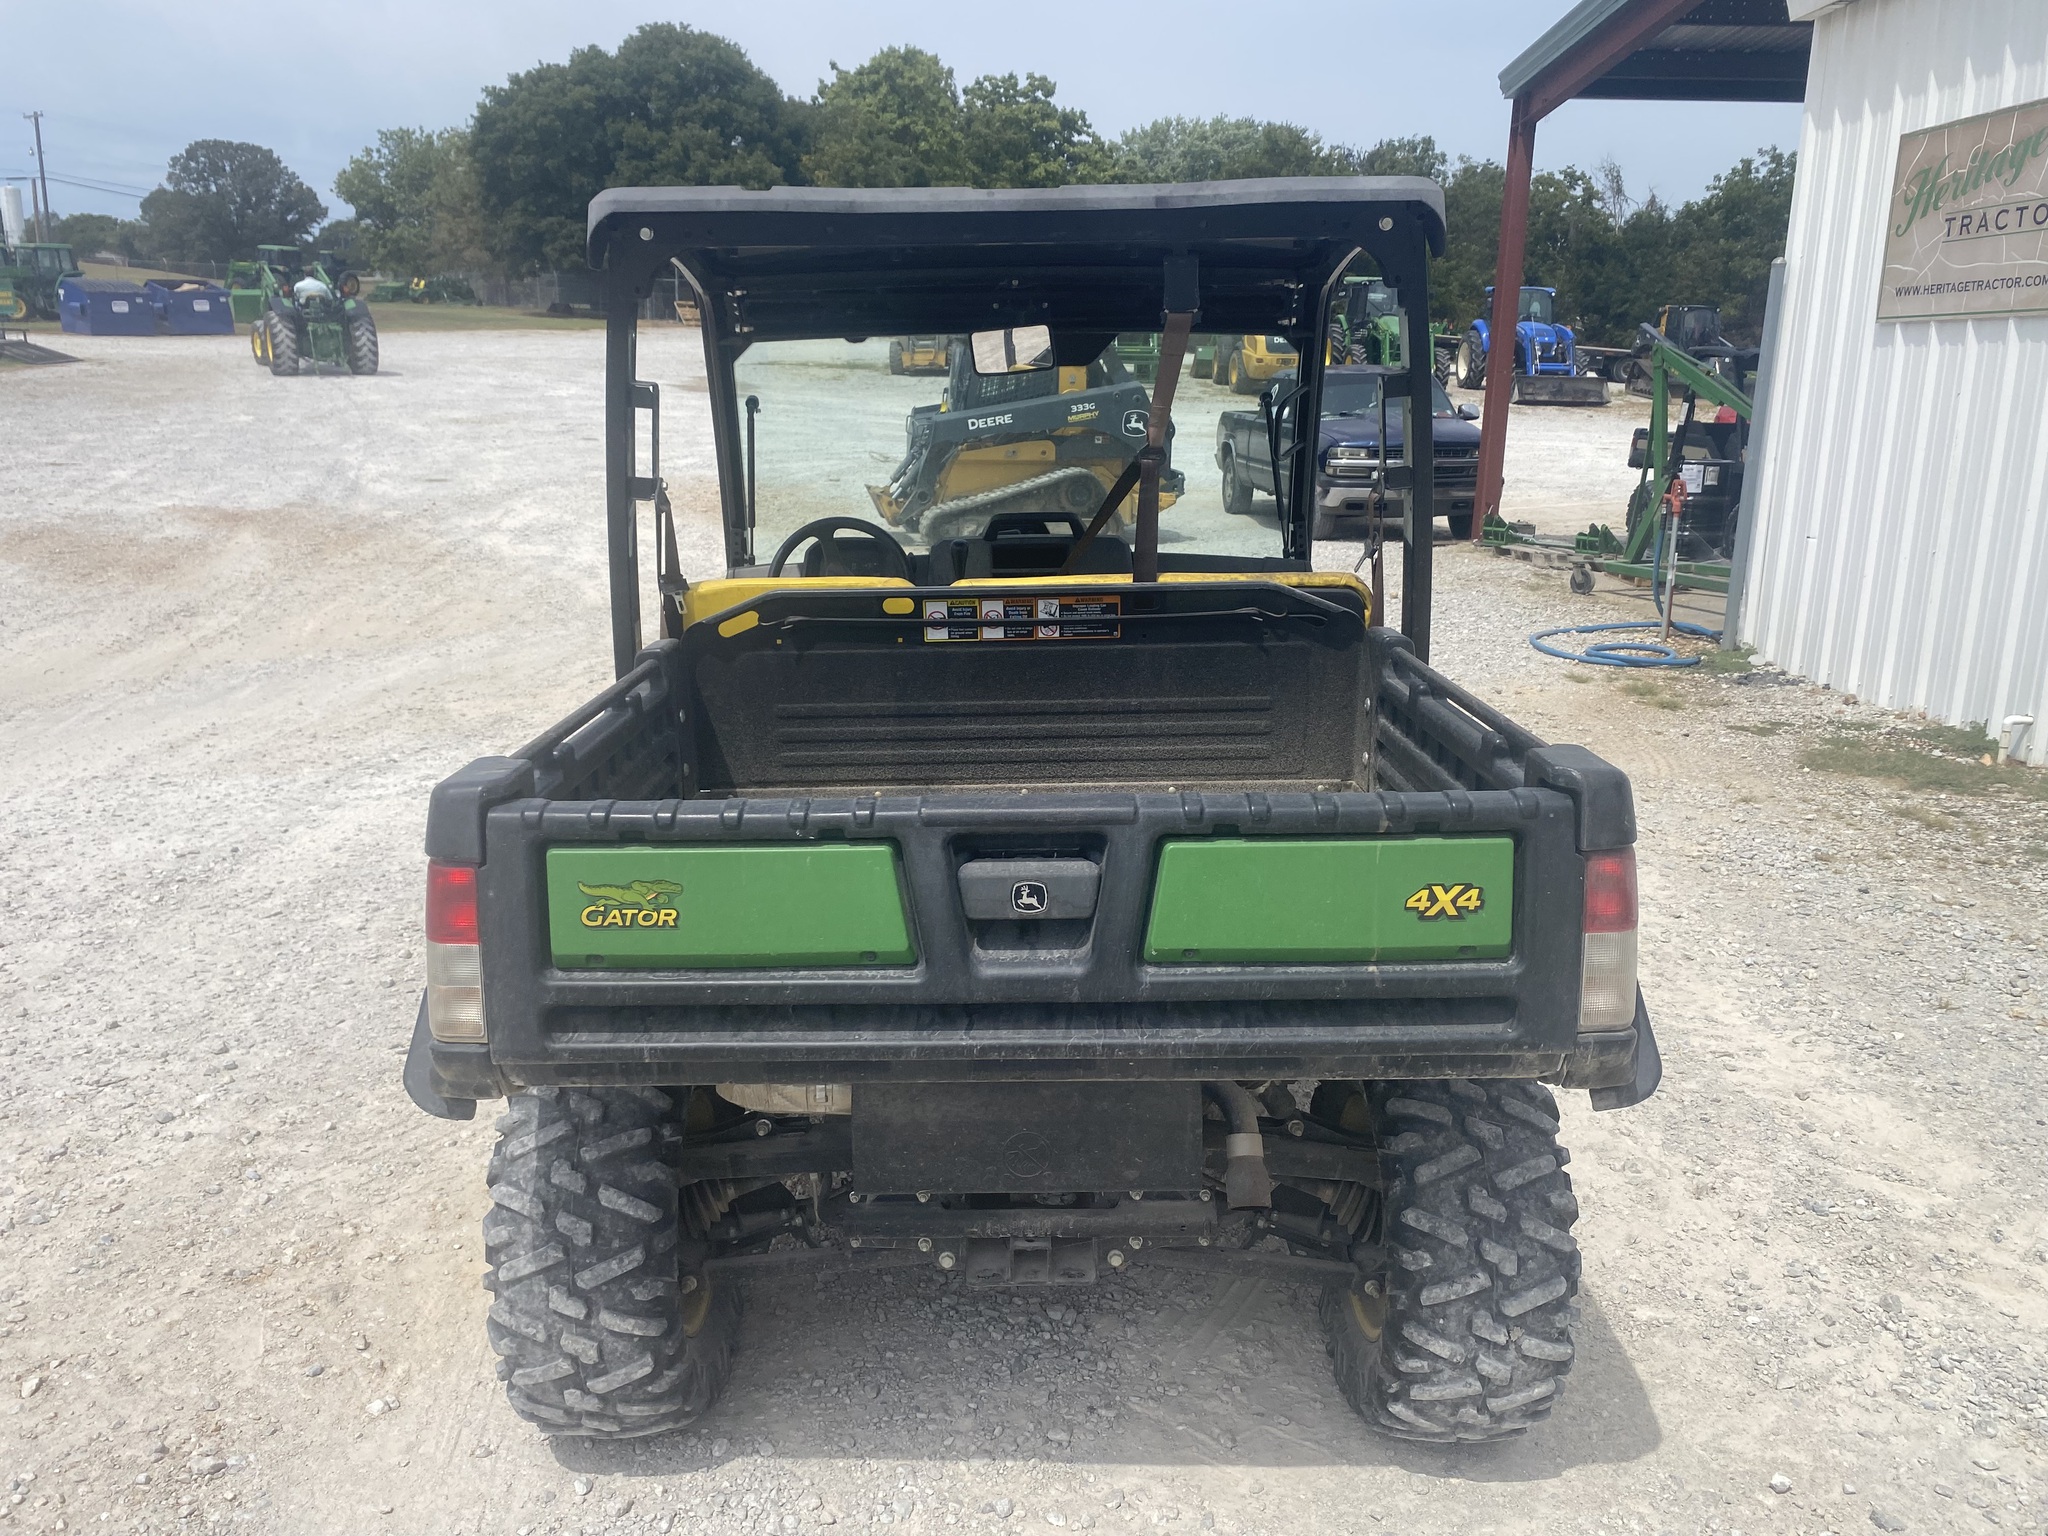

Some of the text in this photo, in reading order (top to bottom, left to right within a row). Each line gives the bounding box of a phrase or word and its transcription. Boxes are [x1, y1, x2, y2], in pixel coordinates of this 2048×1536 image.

[1896, 125, 2048, 237] Heritage
[1944, 202, 2048, 237] TRACTO
[1070, 402, 1096, 413] 333G
[967, 413, 1013, 430] DEERE
[1405, 885, 1482, 916] 4X4
[580, 904, 679, 928] GATOR
